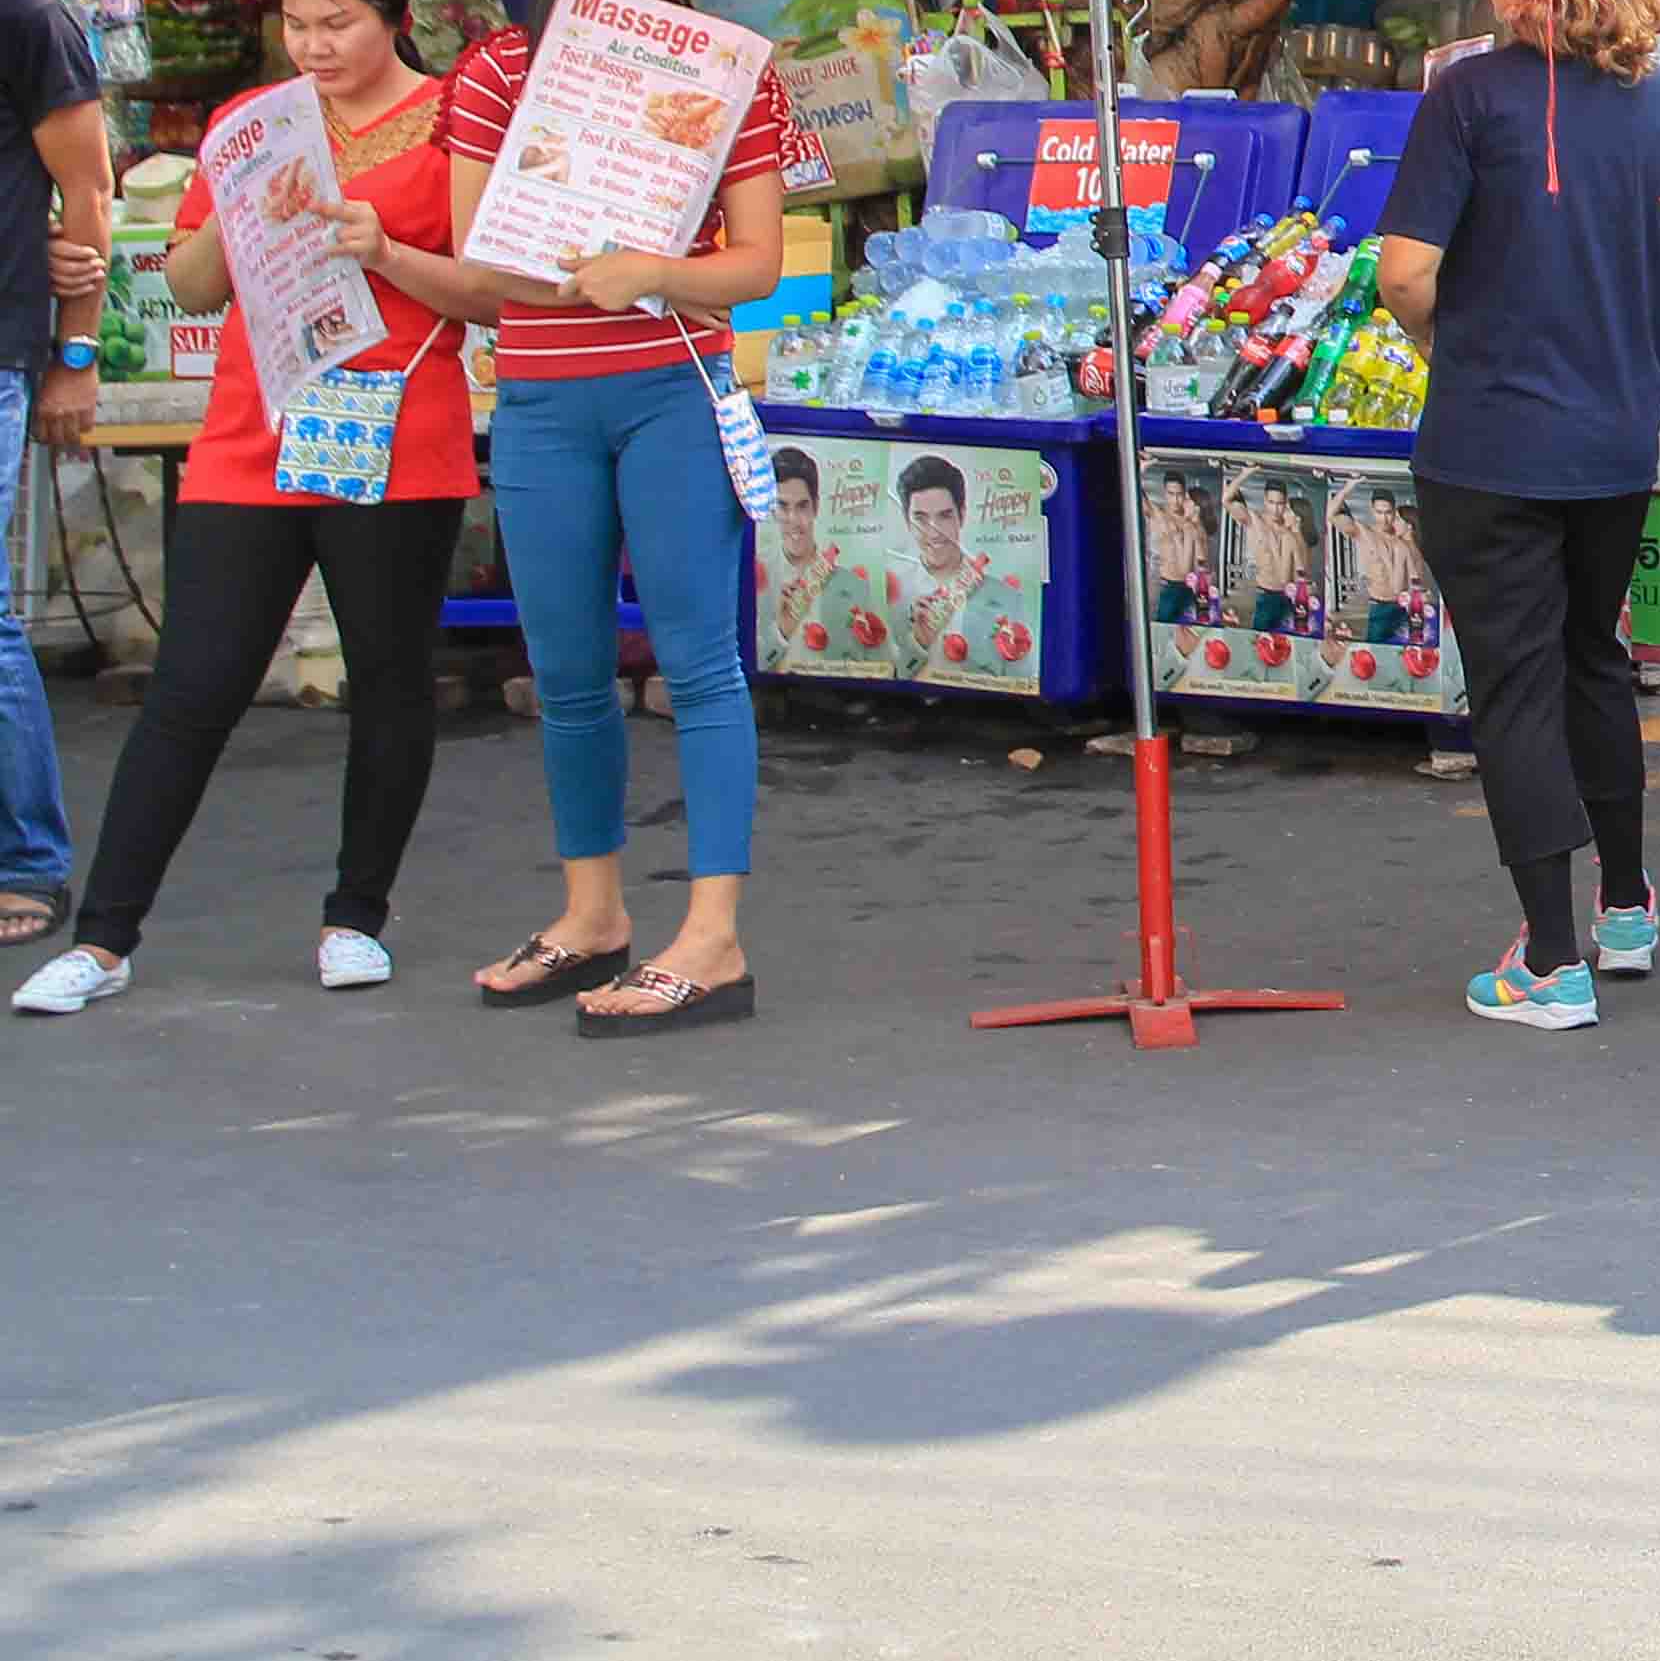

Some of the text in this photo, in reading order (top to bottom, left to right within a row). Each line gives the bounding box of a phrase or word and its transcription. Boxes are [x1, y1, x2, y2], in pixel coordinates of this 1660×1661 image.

[607, 38, 701, 77] Air Condition
[781, 67, 815, 86] NUT
[1041, 134, 1173, 165] Cold ater
[172, 325, 223, 355] SALE
